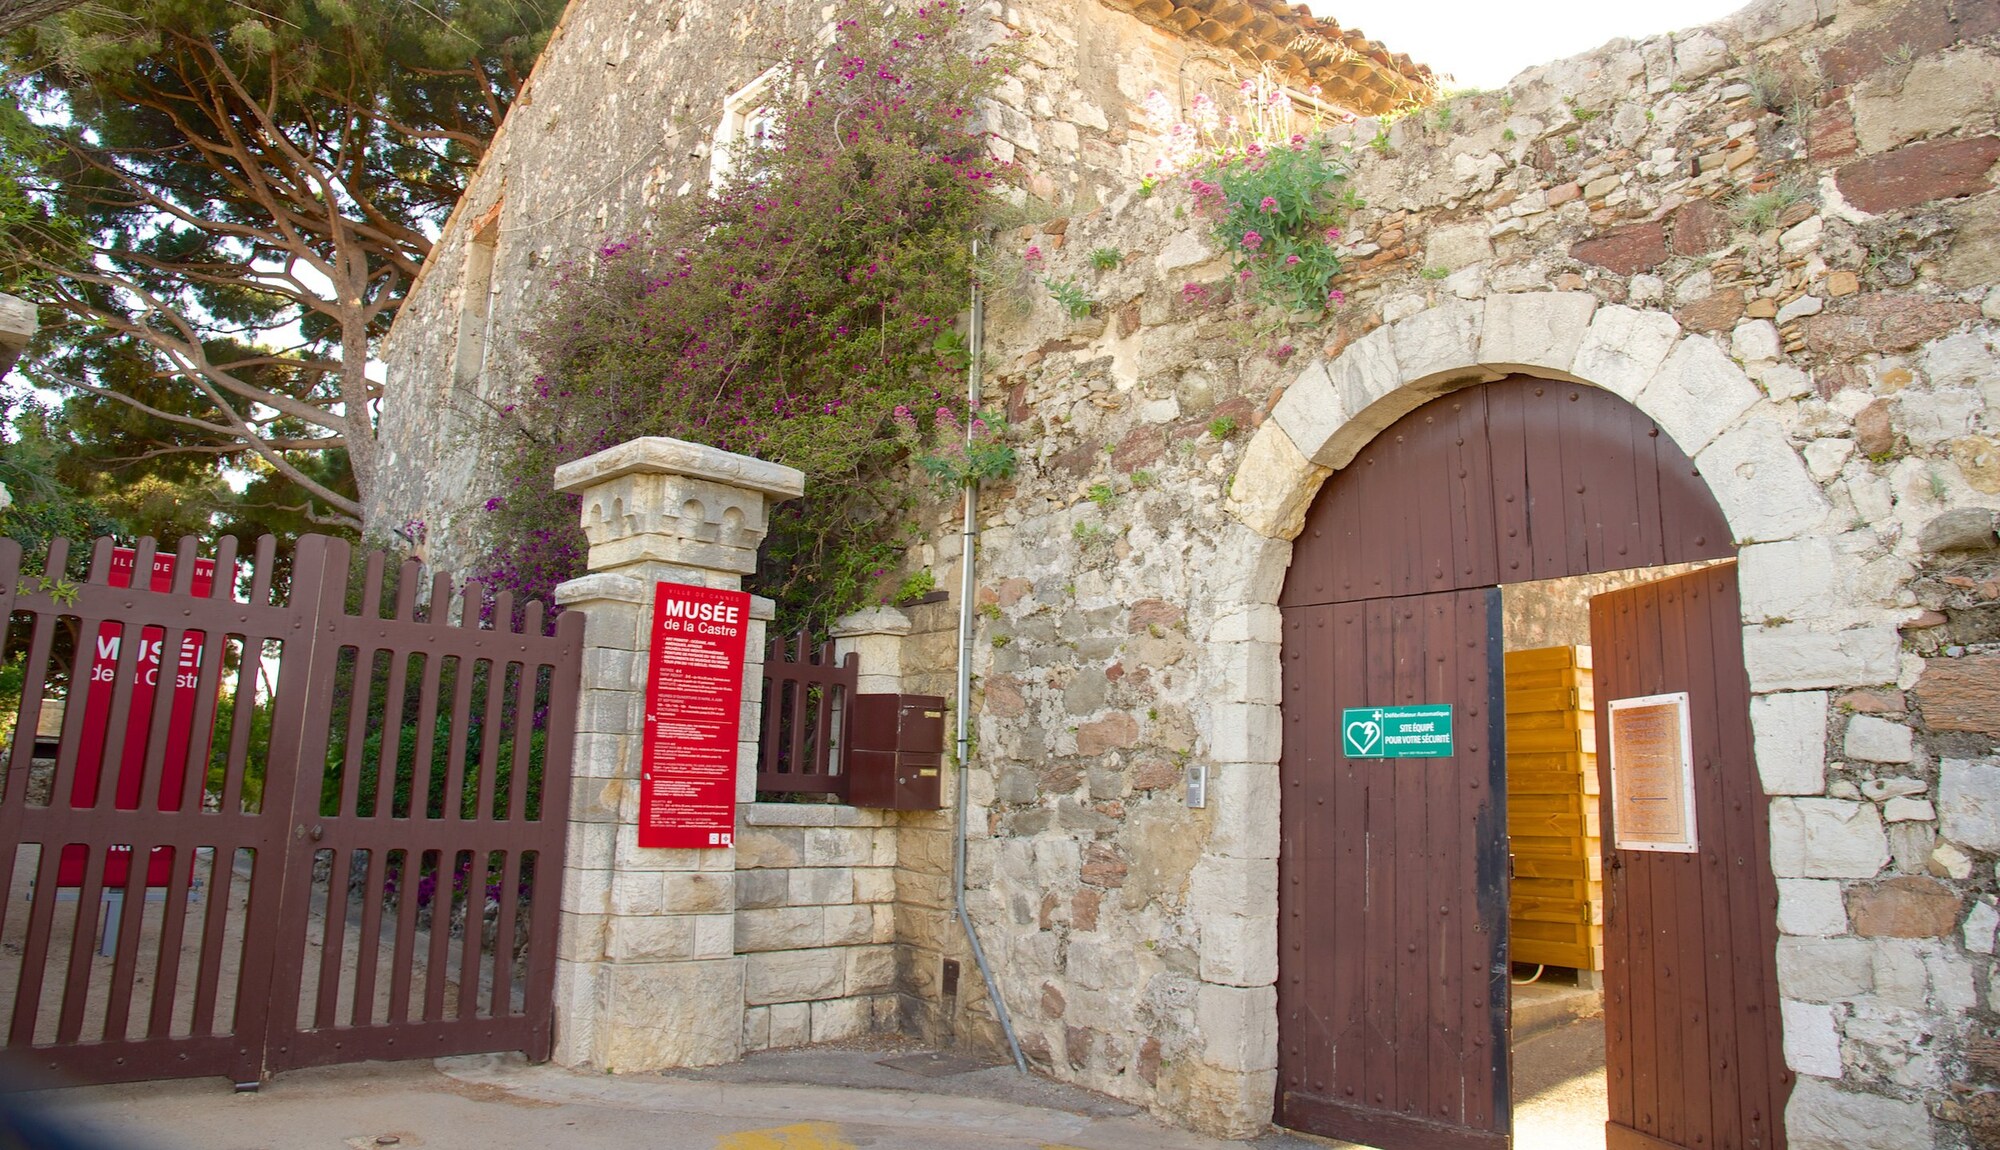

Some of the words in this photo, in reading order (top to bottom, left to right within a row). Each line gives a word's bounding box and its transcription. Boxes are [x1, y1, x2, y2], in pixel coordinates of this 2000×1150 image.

[153, 562, 171, 572] DE
[709, 594, 740, 602] CANNES
[665, 599, 739, 624] MUSÉE
[664, 618, 680, 631] de
[683, 620, 694, 632] la
[698, 622, 737, 637] Castre
[1399, 724, 1412, 733] SITE
[1413, 722, 1434, 732] ÉQUIPÉ
[1385, 735, 1402, 744] POUR
[1402, 735, 1421, 744] VOTRE
[1421, 733, 1450, 743] SÉCURITÉ
